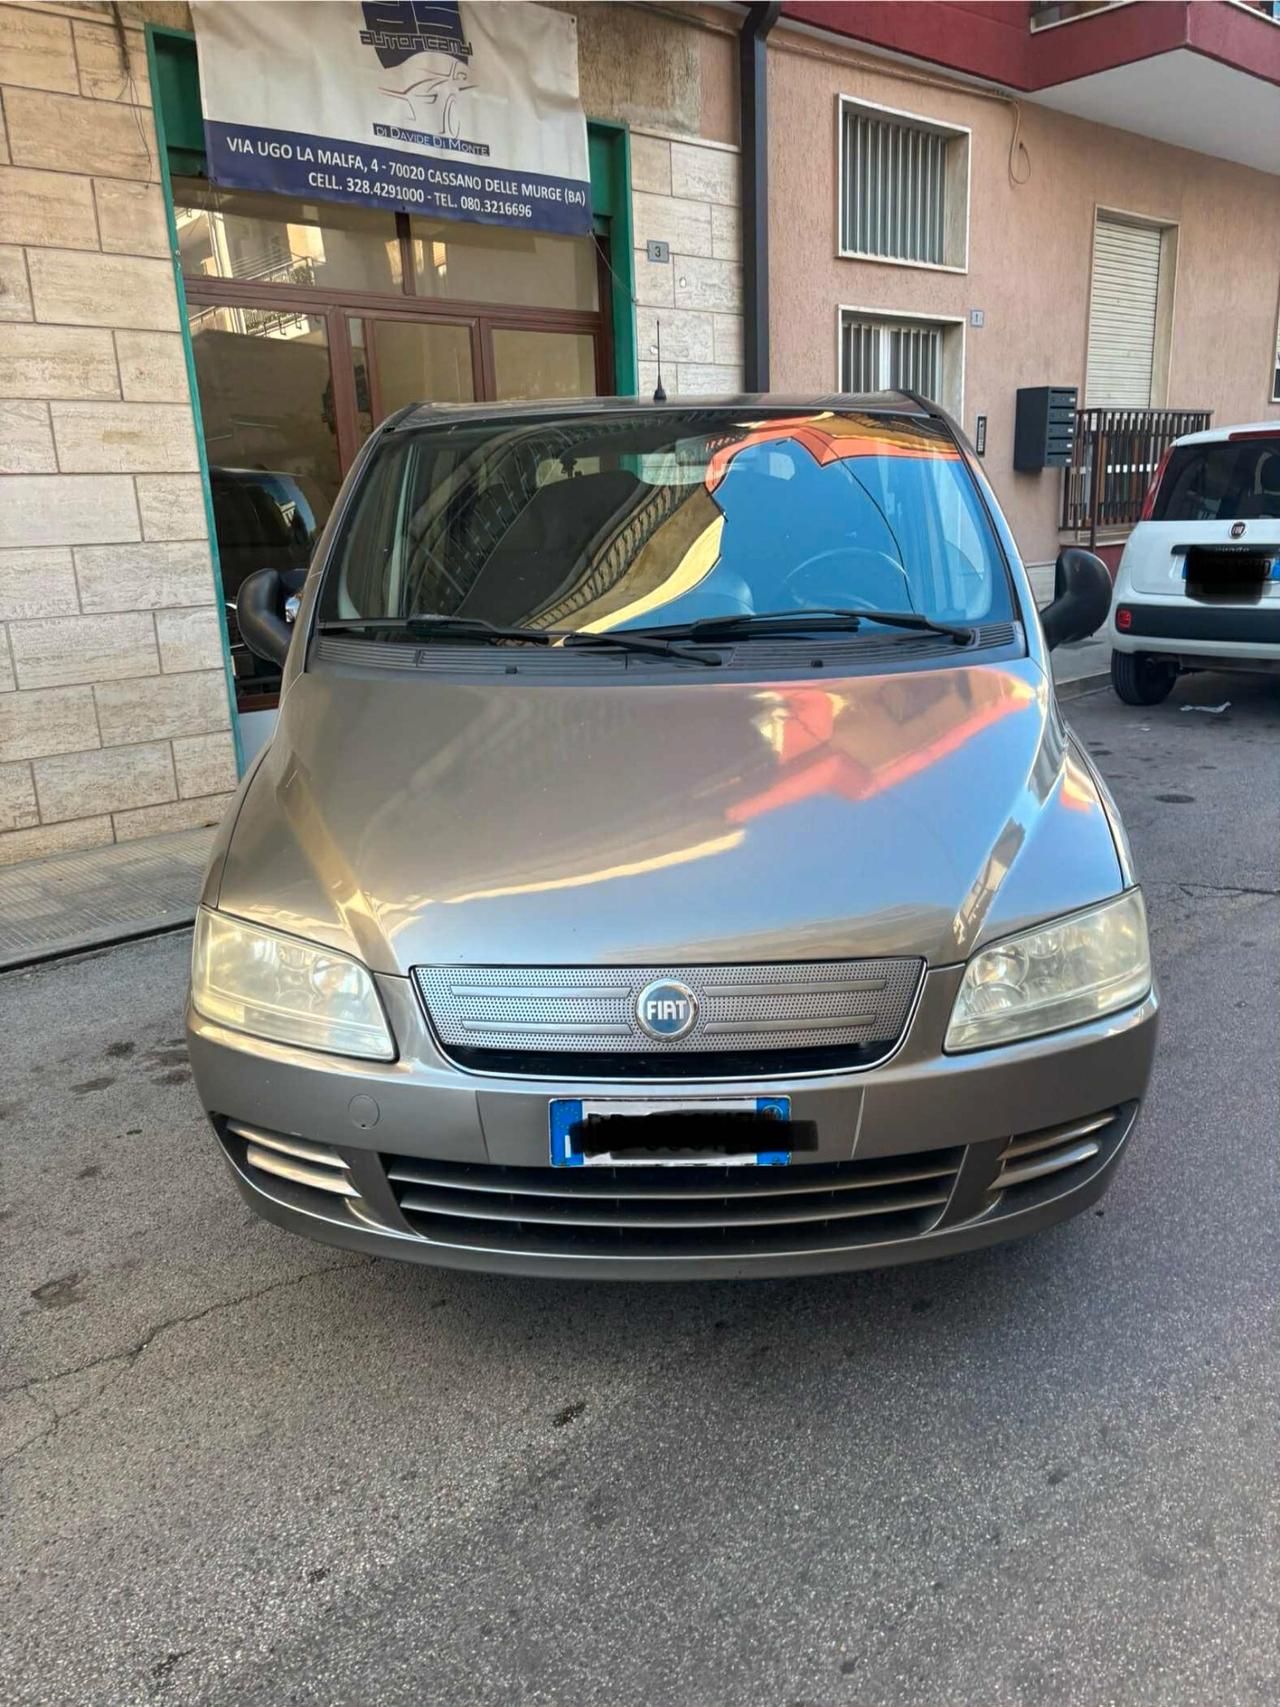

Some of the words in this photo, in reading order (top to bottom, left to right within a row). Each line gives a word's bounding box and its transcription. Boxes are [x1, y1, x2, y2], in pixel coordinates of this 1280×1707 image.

[390, 127, 432, 145] DAVIDE
[449, 137, 488, 155] MONTE
[226, 136, 254, 155] VIA
[258, 140, 293, 159] UGO
[297, 146, 314, 163] LA
[318, 150, 368, 173] MALFA,
[370, 159, 379, 173] 4
[389, 161, 425, 181] 70020
[428, 169, 482, 191] CASSANO
[485, 178, 518, 196] DELLE
[521, 183, 562, 202] MURGE
[564, 188, 586, 207] (BA)
[308, 171, 343, 191] CELL.
[346, 177, 424, 203] 328.4291000
[434, 192, 458, 208] TEL.
[460, 196, 532, 218] 080.3216696
[654, 246, 661, 258] 3
[646, 1000, 687, 1020] FIAT
